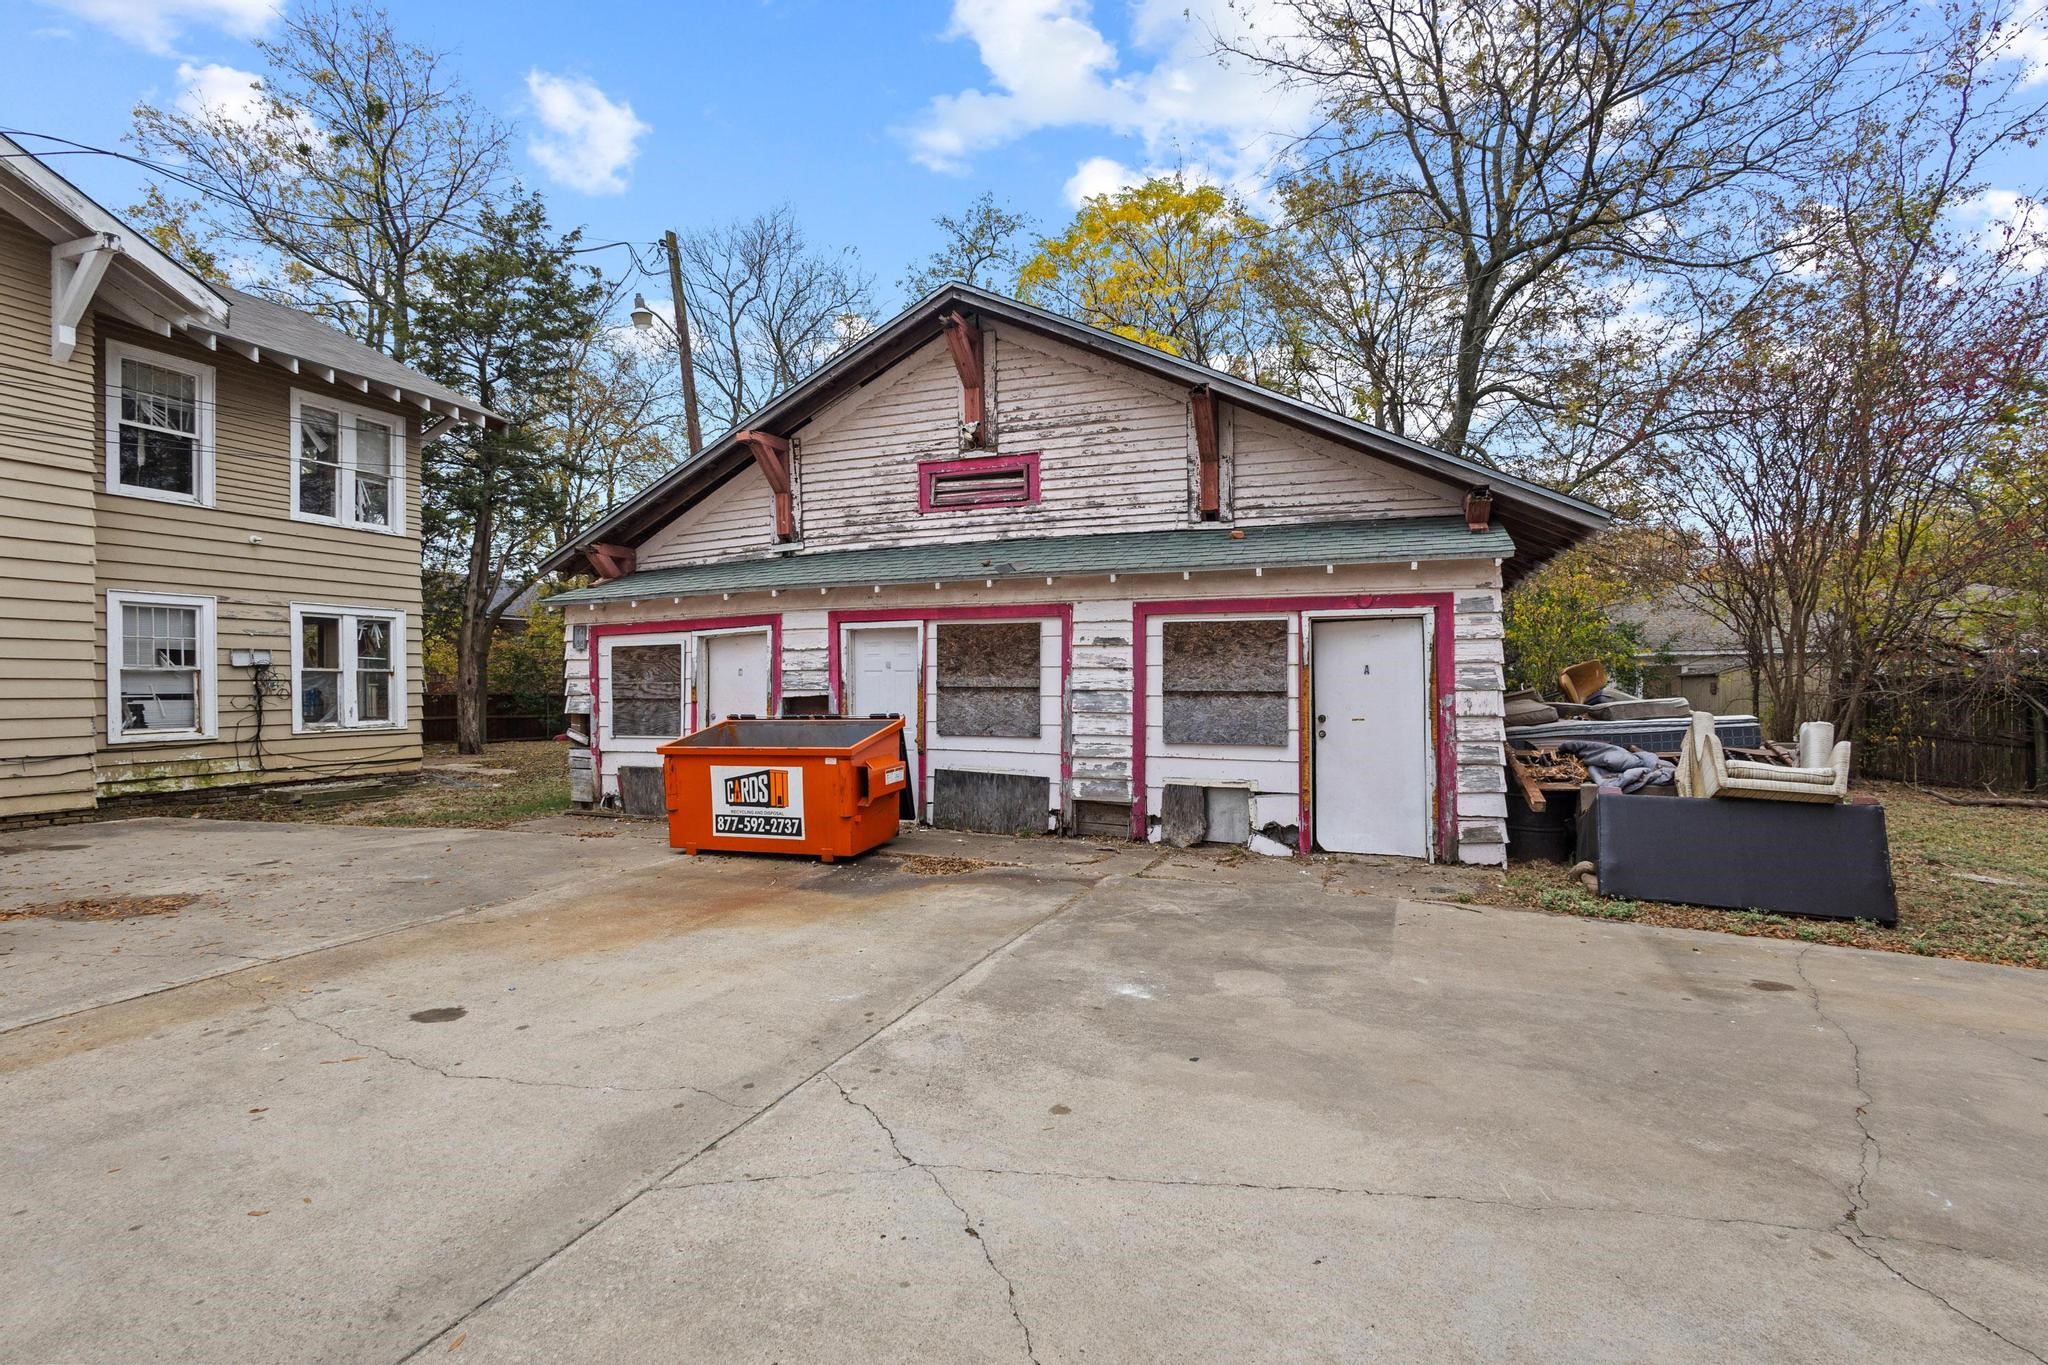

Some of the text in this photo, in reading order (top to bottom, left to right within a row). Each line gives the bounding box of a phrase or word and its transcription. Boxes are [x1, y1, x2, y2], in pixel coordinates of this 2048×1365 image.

[1363, 664, 1370, 675] A
[727, 774, 769, 803] CARDS
[717, 816, 799, 834] 877-592-2737
